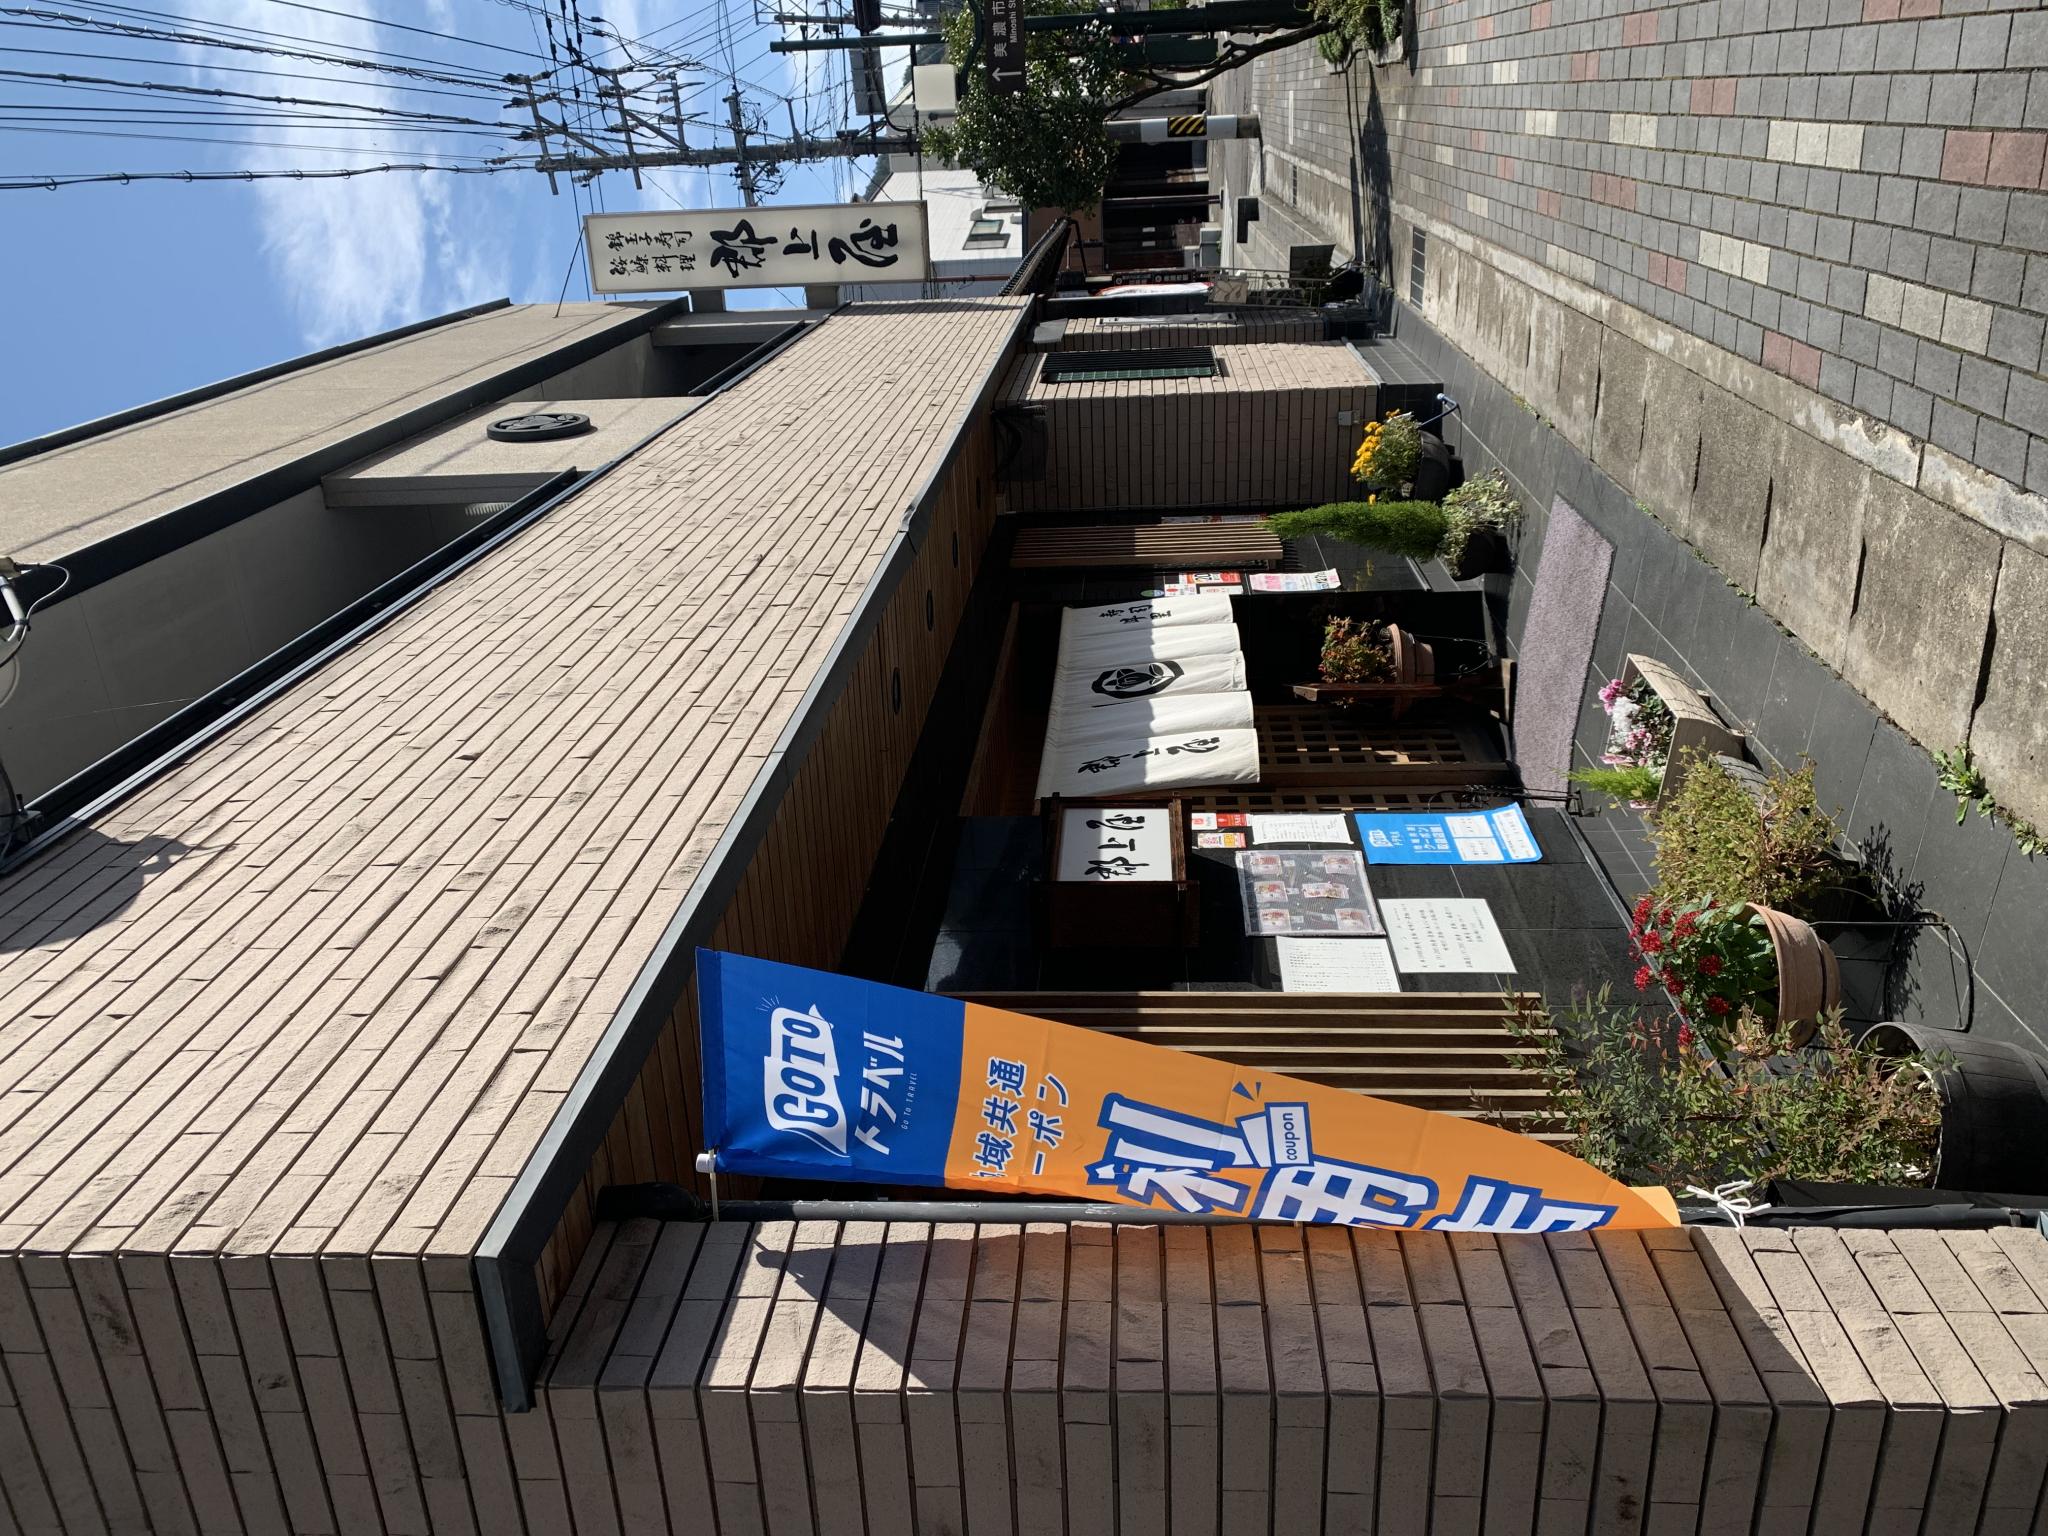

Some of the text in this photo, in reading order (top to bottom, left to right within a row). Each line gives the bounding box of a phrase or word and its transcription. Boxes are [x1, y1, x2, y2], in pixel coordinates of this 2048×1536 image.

[1009, 11, 1018, 43] Minoshi
[709, 217, 899, 279] 郡上屋
[1084, 813, 1150, 880] 郡上屋
[854, 1029, 906, 1156] トラベル
[1280, 1112, 1300, 1161] coupon
